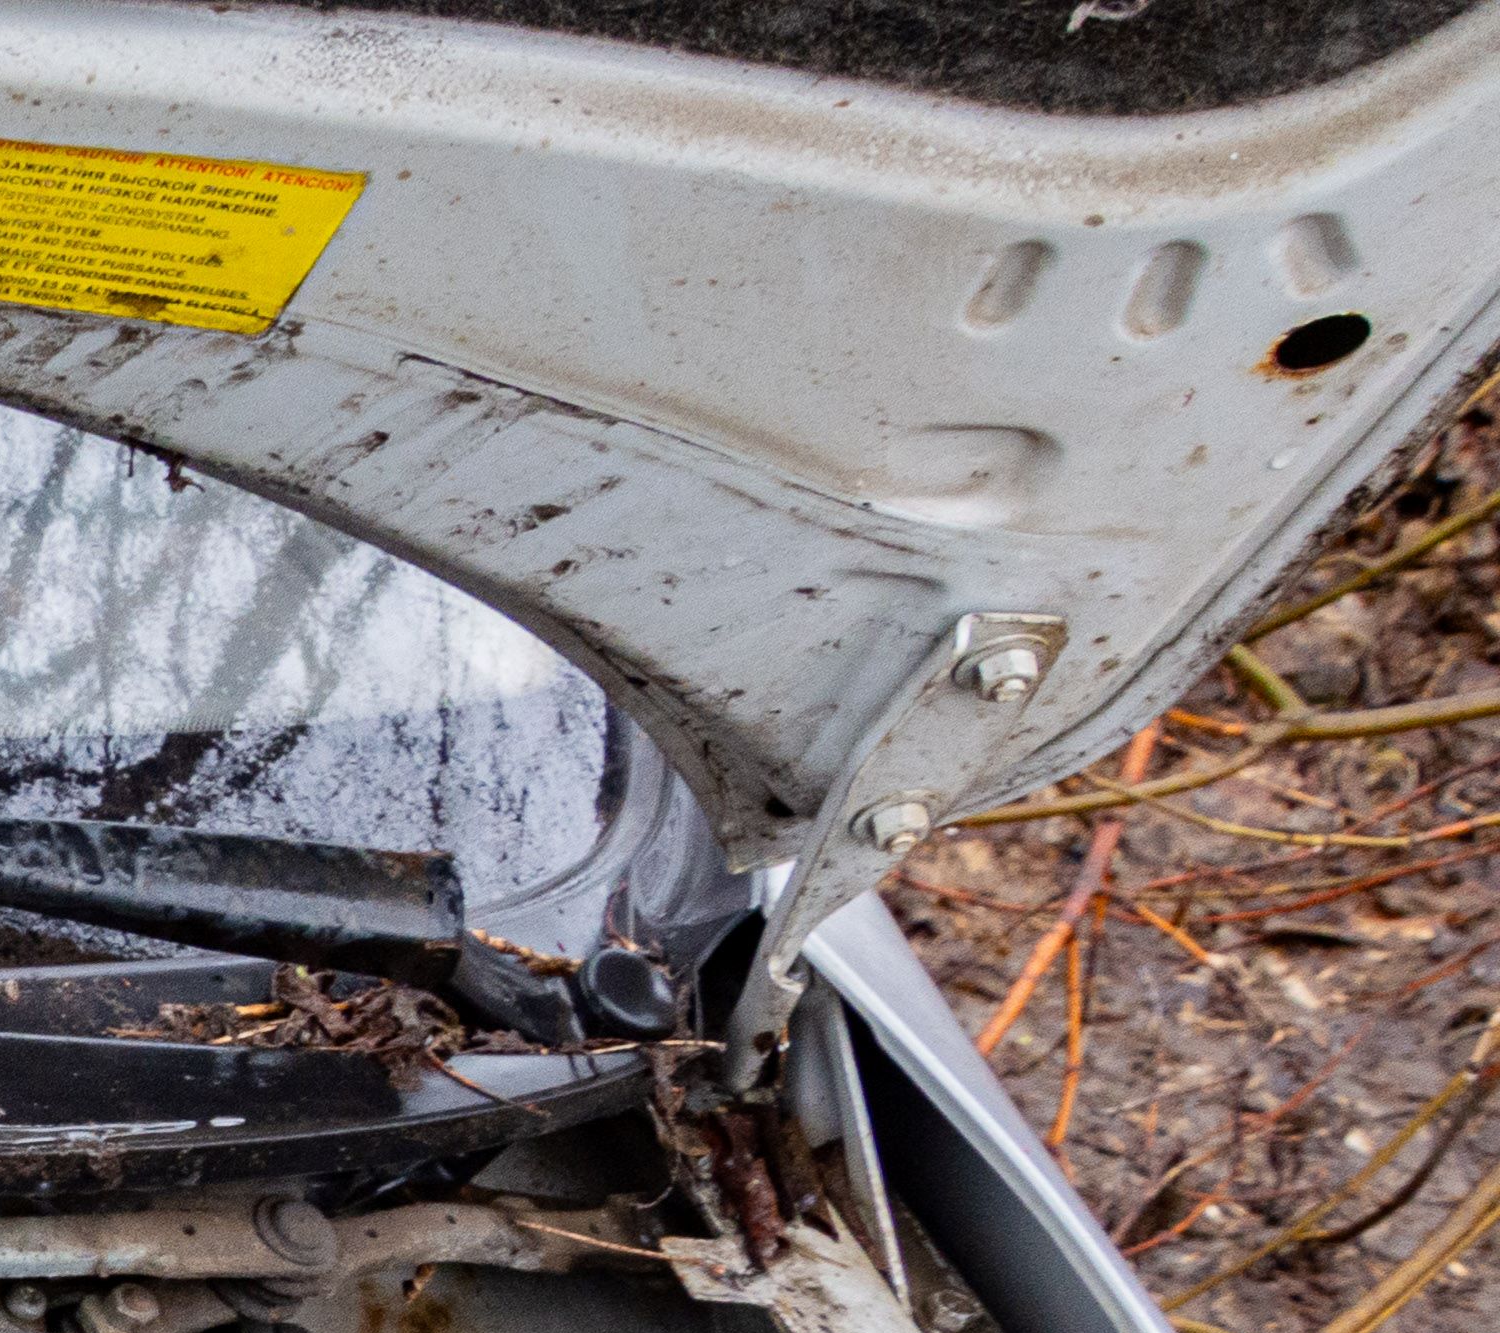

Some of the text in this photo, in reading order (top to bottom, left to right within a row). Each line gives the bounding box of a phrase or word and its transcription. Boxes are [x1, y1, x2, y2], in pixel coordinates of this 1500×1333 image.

[107, 172, 198, 192] ВЫСОКОЙ
[152, 156, 256, 179] ATTENTION!
[258, 169, 356, 192] ATENCION!
[70, 182, 85, 192] И
[86, 184, 157, 201] НИЗКОЕ
[53, 208, 88, 220] UND
[30, 234, 62, 247] AND
[61, 238, 148, 258] SECONDARY
[44, 251, 95, 266] HAUTE
[10, 260, 32, 271] ET
[32, 263, 133, 284] SECONDAIRE
